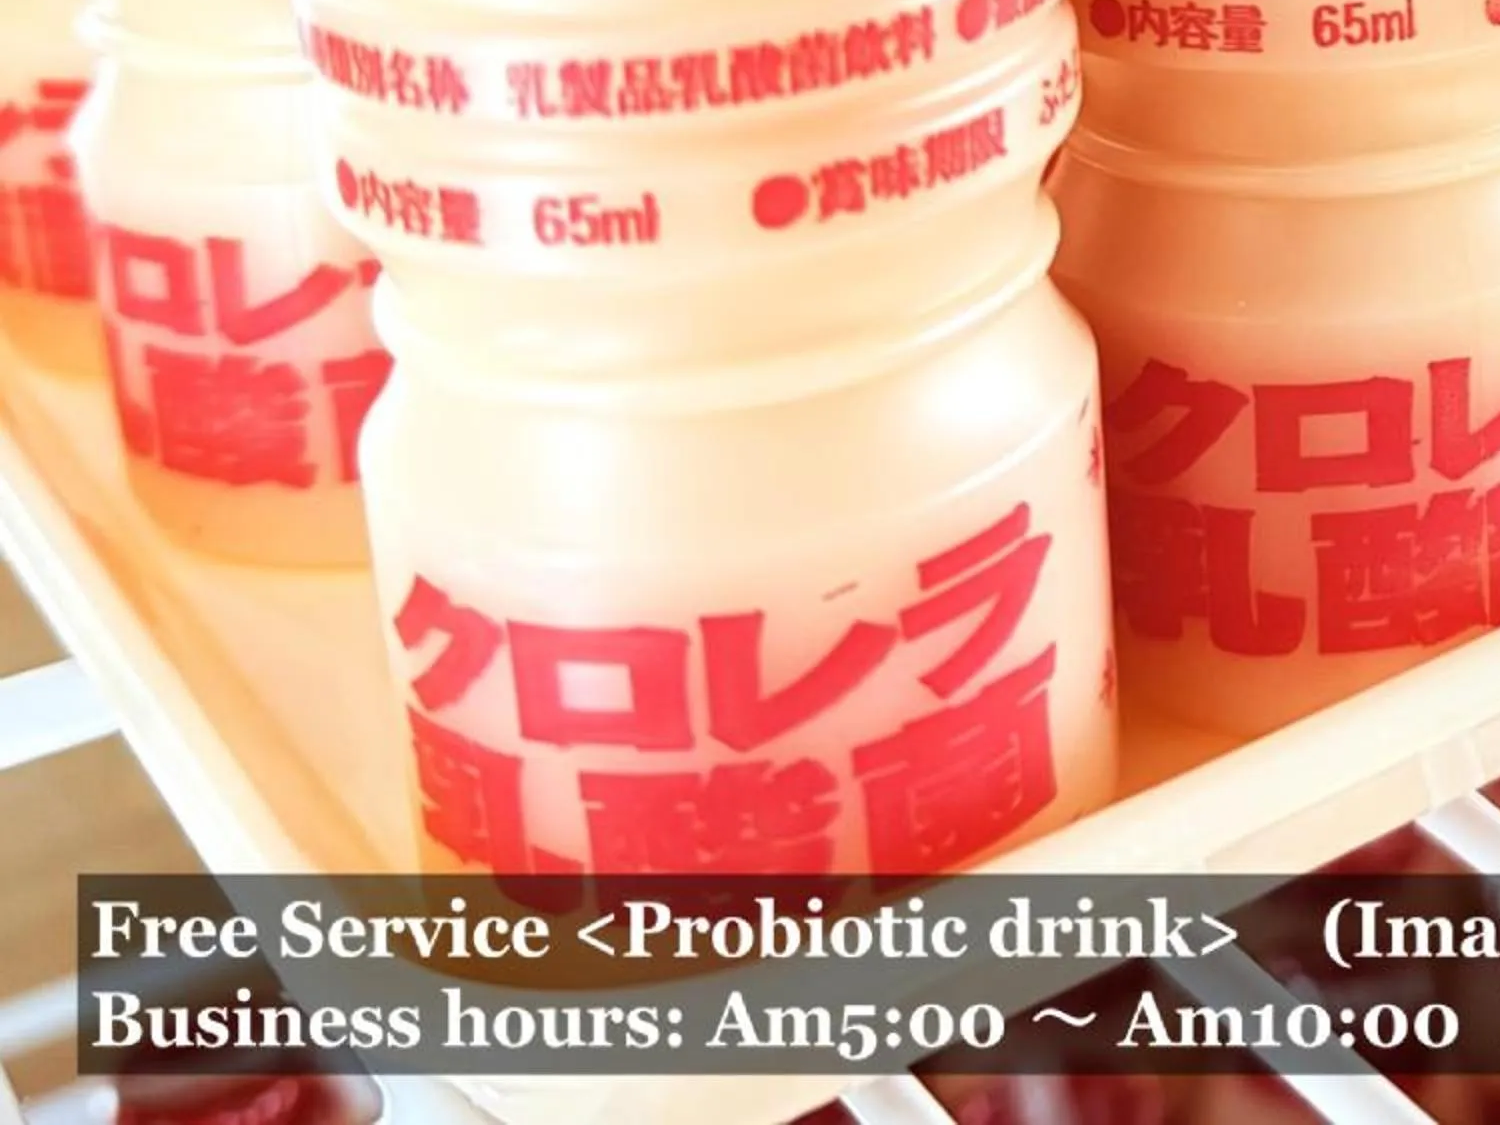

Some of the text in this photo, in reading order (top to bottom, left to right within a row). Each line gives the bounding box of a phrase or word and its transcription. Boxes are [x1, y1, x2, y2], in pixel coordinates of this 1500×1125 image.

[506, 5, 937, 120] 乳製品乳酸菌飲料
[358, 167, 483, 246] 内容量
[532, 190, 660, 246] 65ml
[393, 502, 1052, 752] クロレラ
